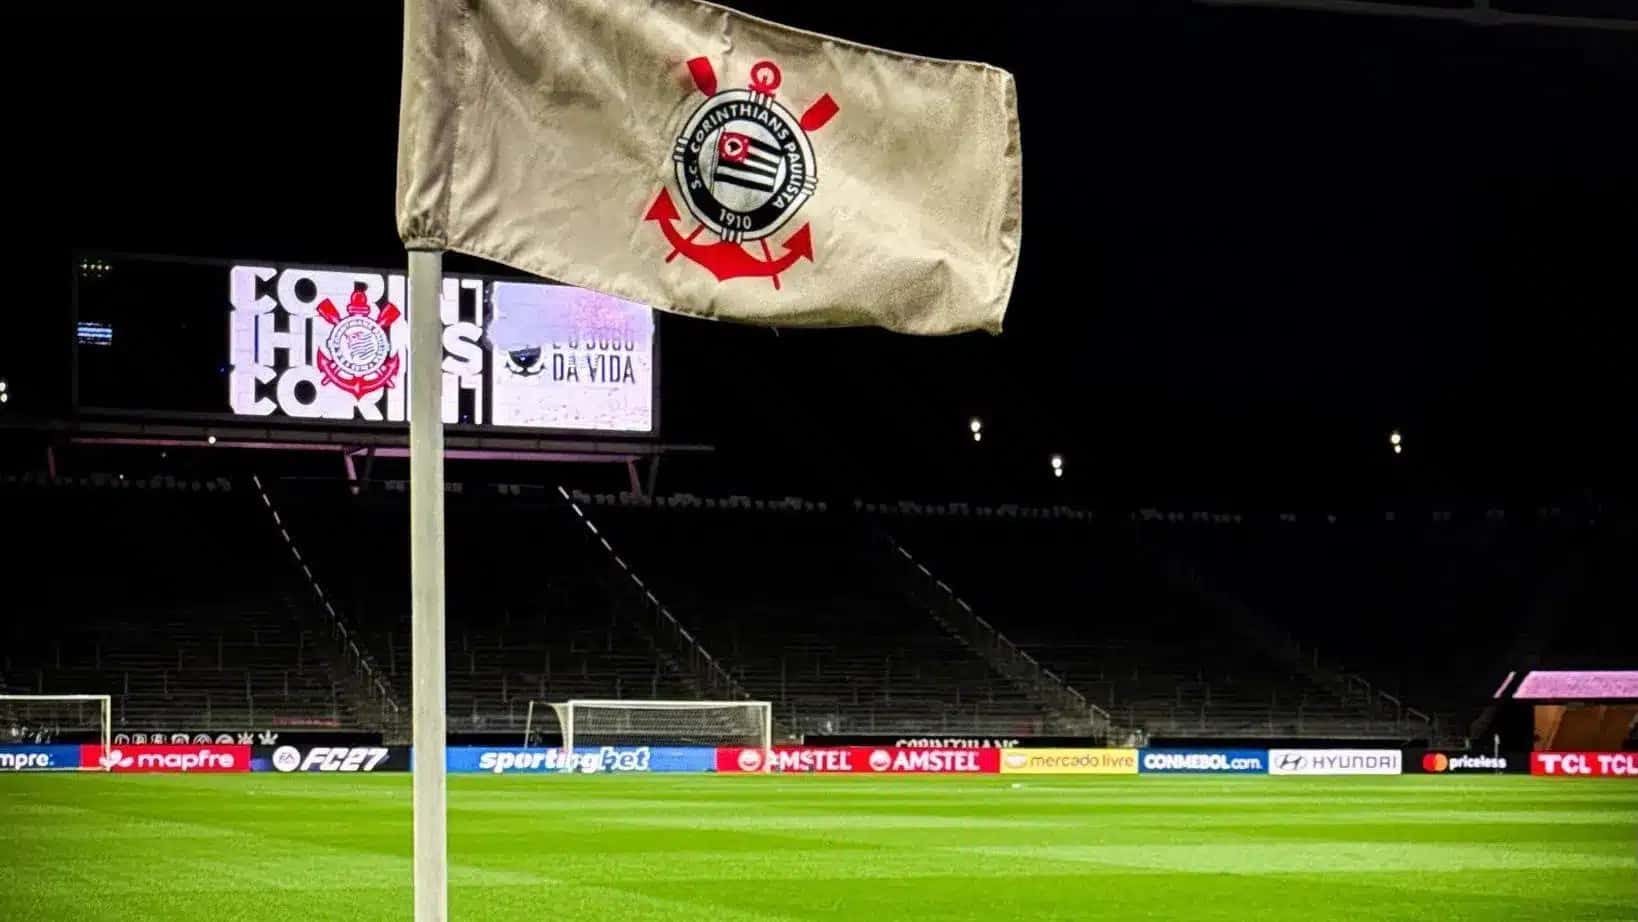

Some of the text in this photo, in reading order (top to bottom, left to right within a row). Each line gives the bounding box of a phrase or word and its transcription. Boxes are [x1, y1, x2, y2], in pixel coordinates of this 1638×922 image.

[691, 104, 790, 153] CORINTHIANS
[772, 142, 800, 208] PAULISTA
[719, 210, 752, 229] 1910
[553, 353, 636, 385] DA VIDA
[138, 747, 234, 770] mapfre
[300, 747, 389, 772] FC27
[892, 751, 980, 771] AMSTEL
[1031, 754, 1135, 768] mercado livre
[1313, 755, 1397, 769] HYUNDAI
[1449, 755, 1507, 770] priceless
[1538, 753, 1638, 774] TCL TCL
